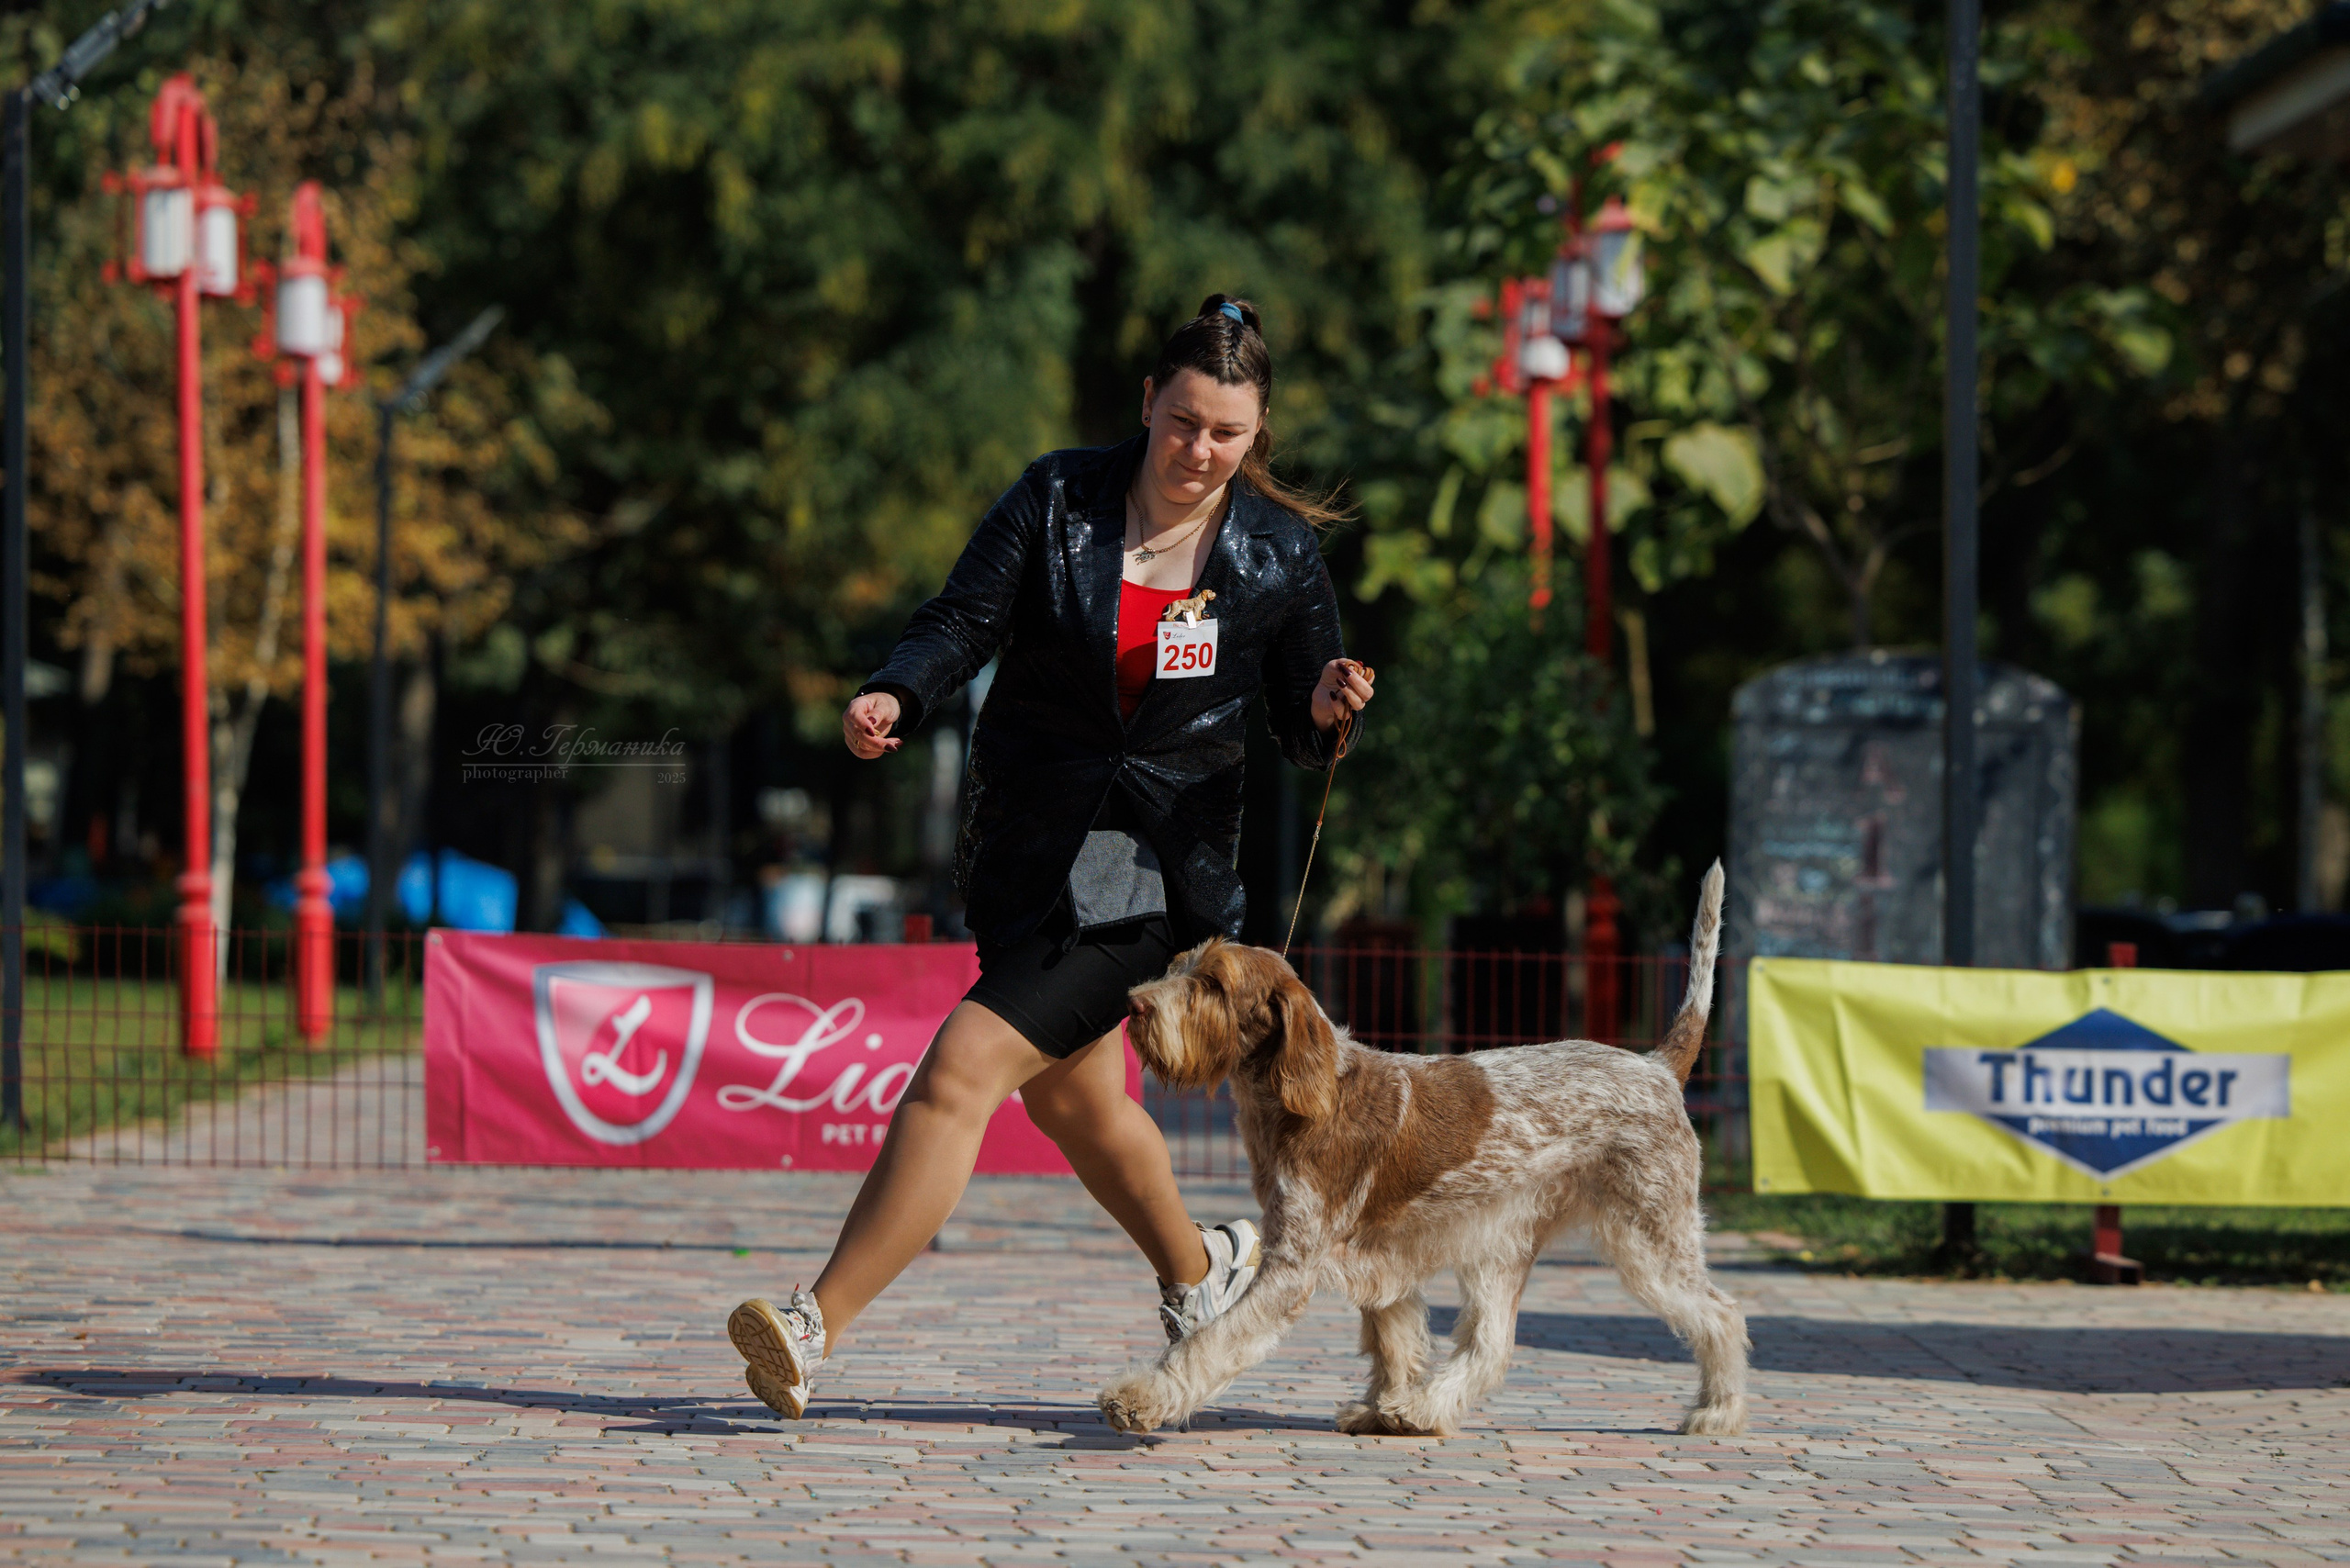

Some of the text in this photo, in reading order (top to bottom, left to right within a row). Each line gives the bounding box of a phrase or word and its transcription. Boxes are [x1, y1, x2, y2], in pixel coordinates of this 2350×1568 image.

[1163, 643, 1213, 671] 250
[581, 994, 667, 1096] L
[1978, 1053, 2238, 1107] Thunder
[822, 1124, 868, 1146] PET
